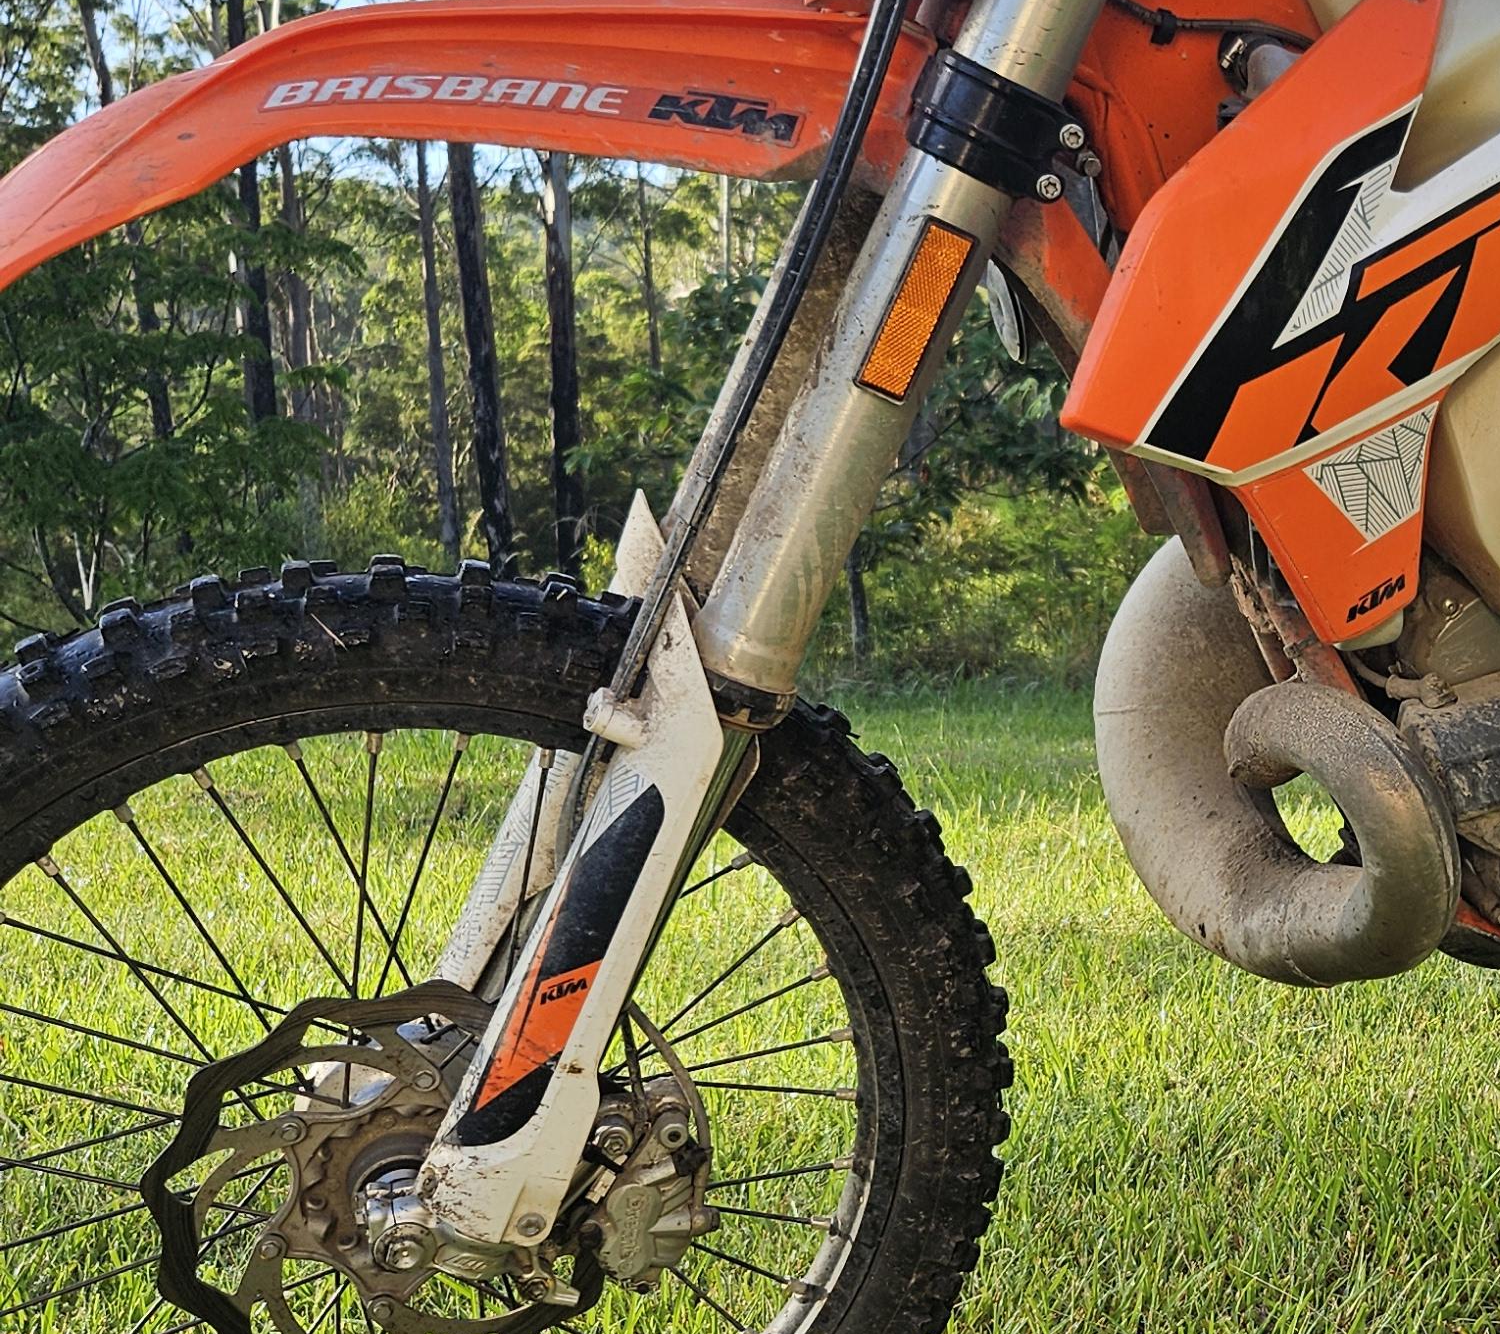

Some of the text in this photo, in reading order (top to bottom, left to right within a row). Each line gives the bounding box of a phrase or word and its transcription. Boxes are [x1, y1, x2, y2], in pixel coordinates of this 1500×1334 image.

[263, 76, 797, 142] BRISBANE KTM
[1346, 574, 1405, 624] KTM
[540, 978, 588, 1005] KTM
